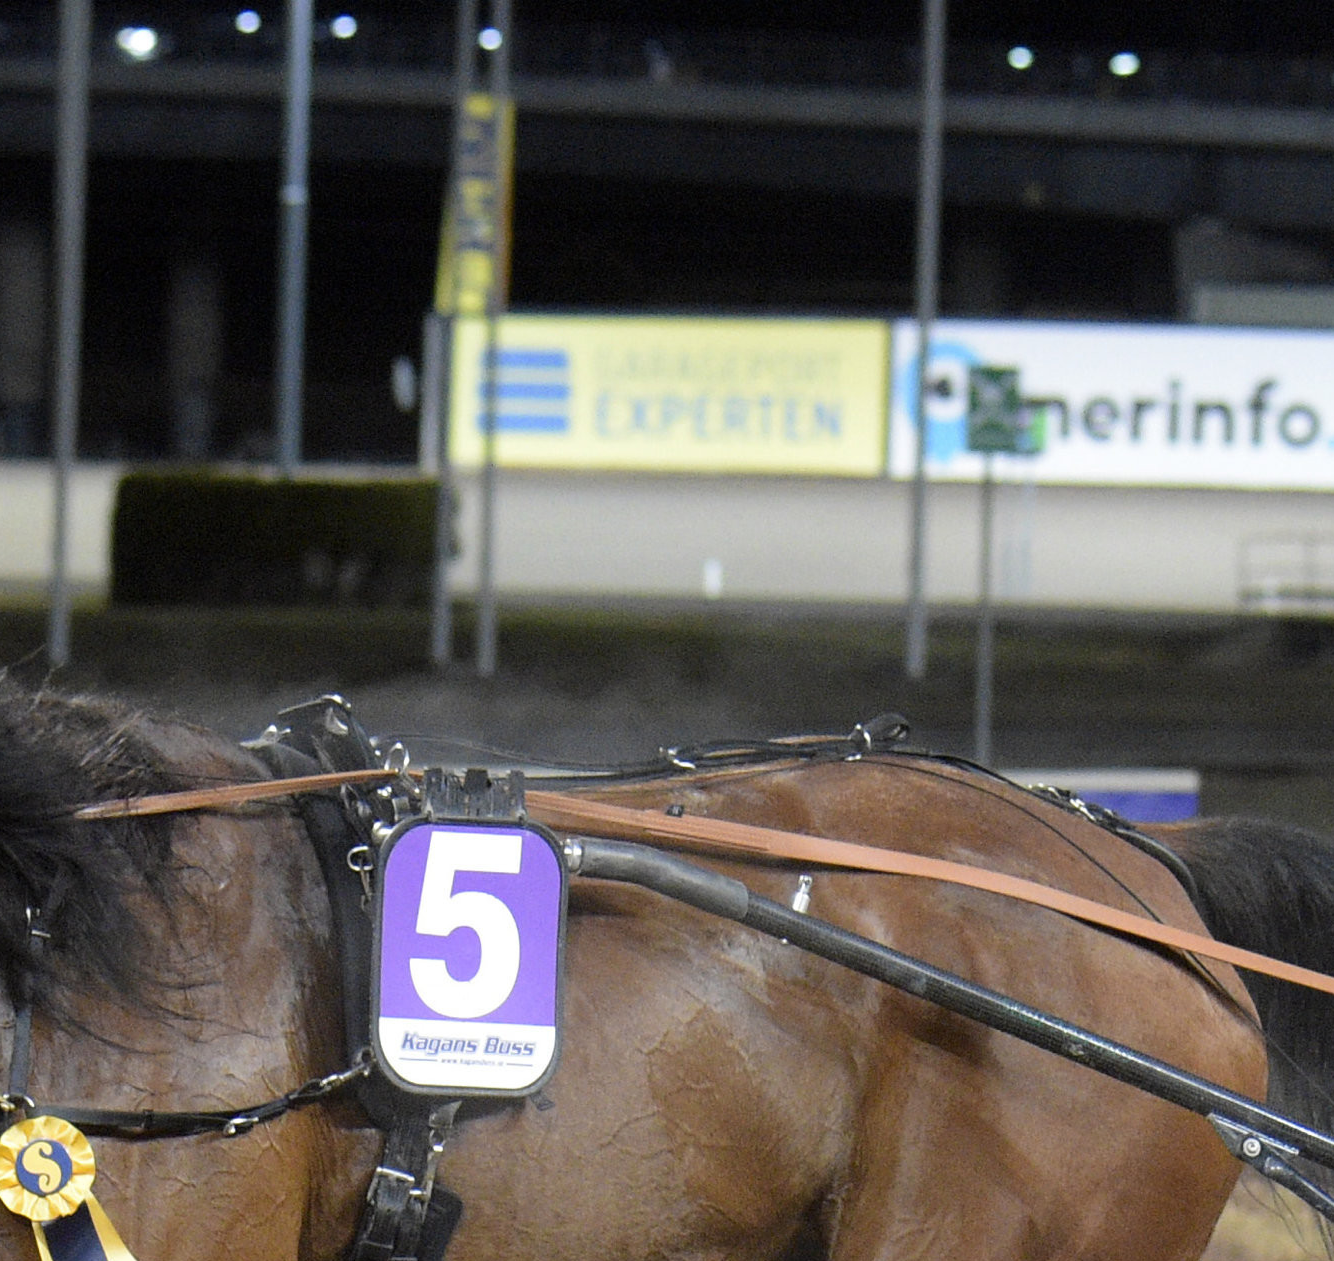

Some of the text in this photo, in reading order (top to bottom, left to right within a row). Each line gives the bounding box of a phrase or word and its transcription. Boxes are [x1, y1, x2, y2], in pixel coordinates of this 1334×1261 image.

[593, 392, 845, 440] EXPERTEN
[409, 831, 523, 1020] 5
[400, 1031, 535, 1057] Kagans Buss
